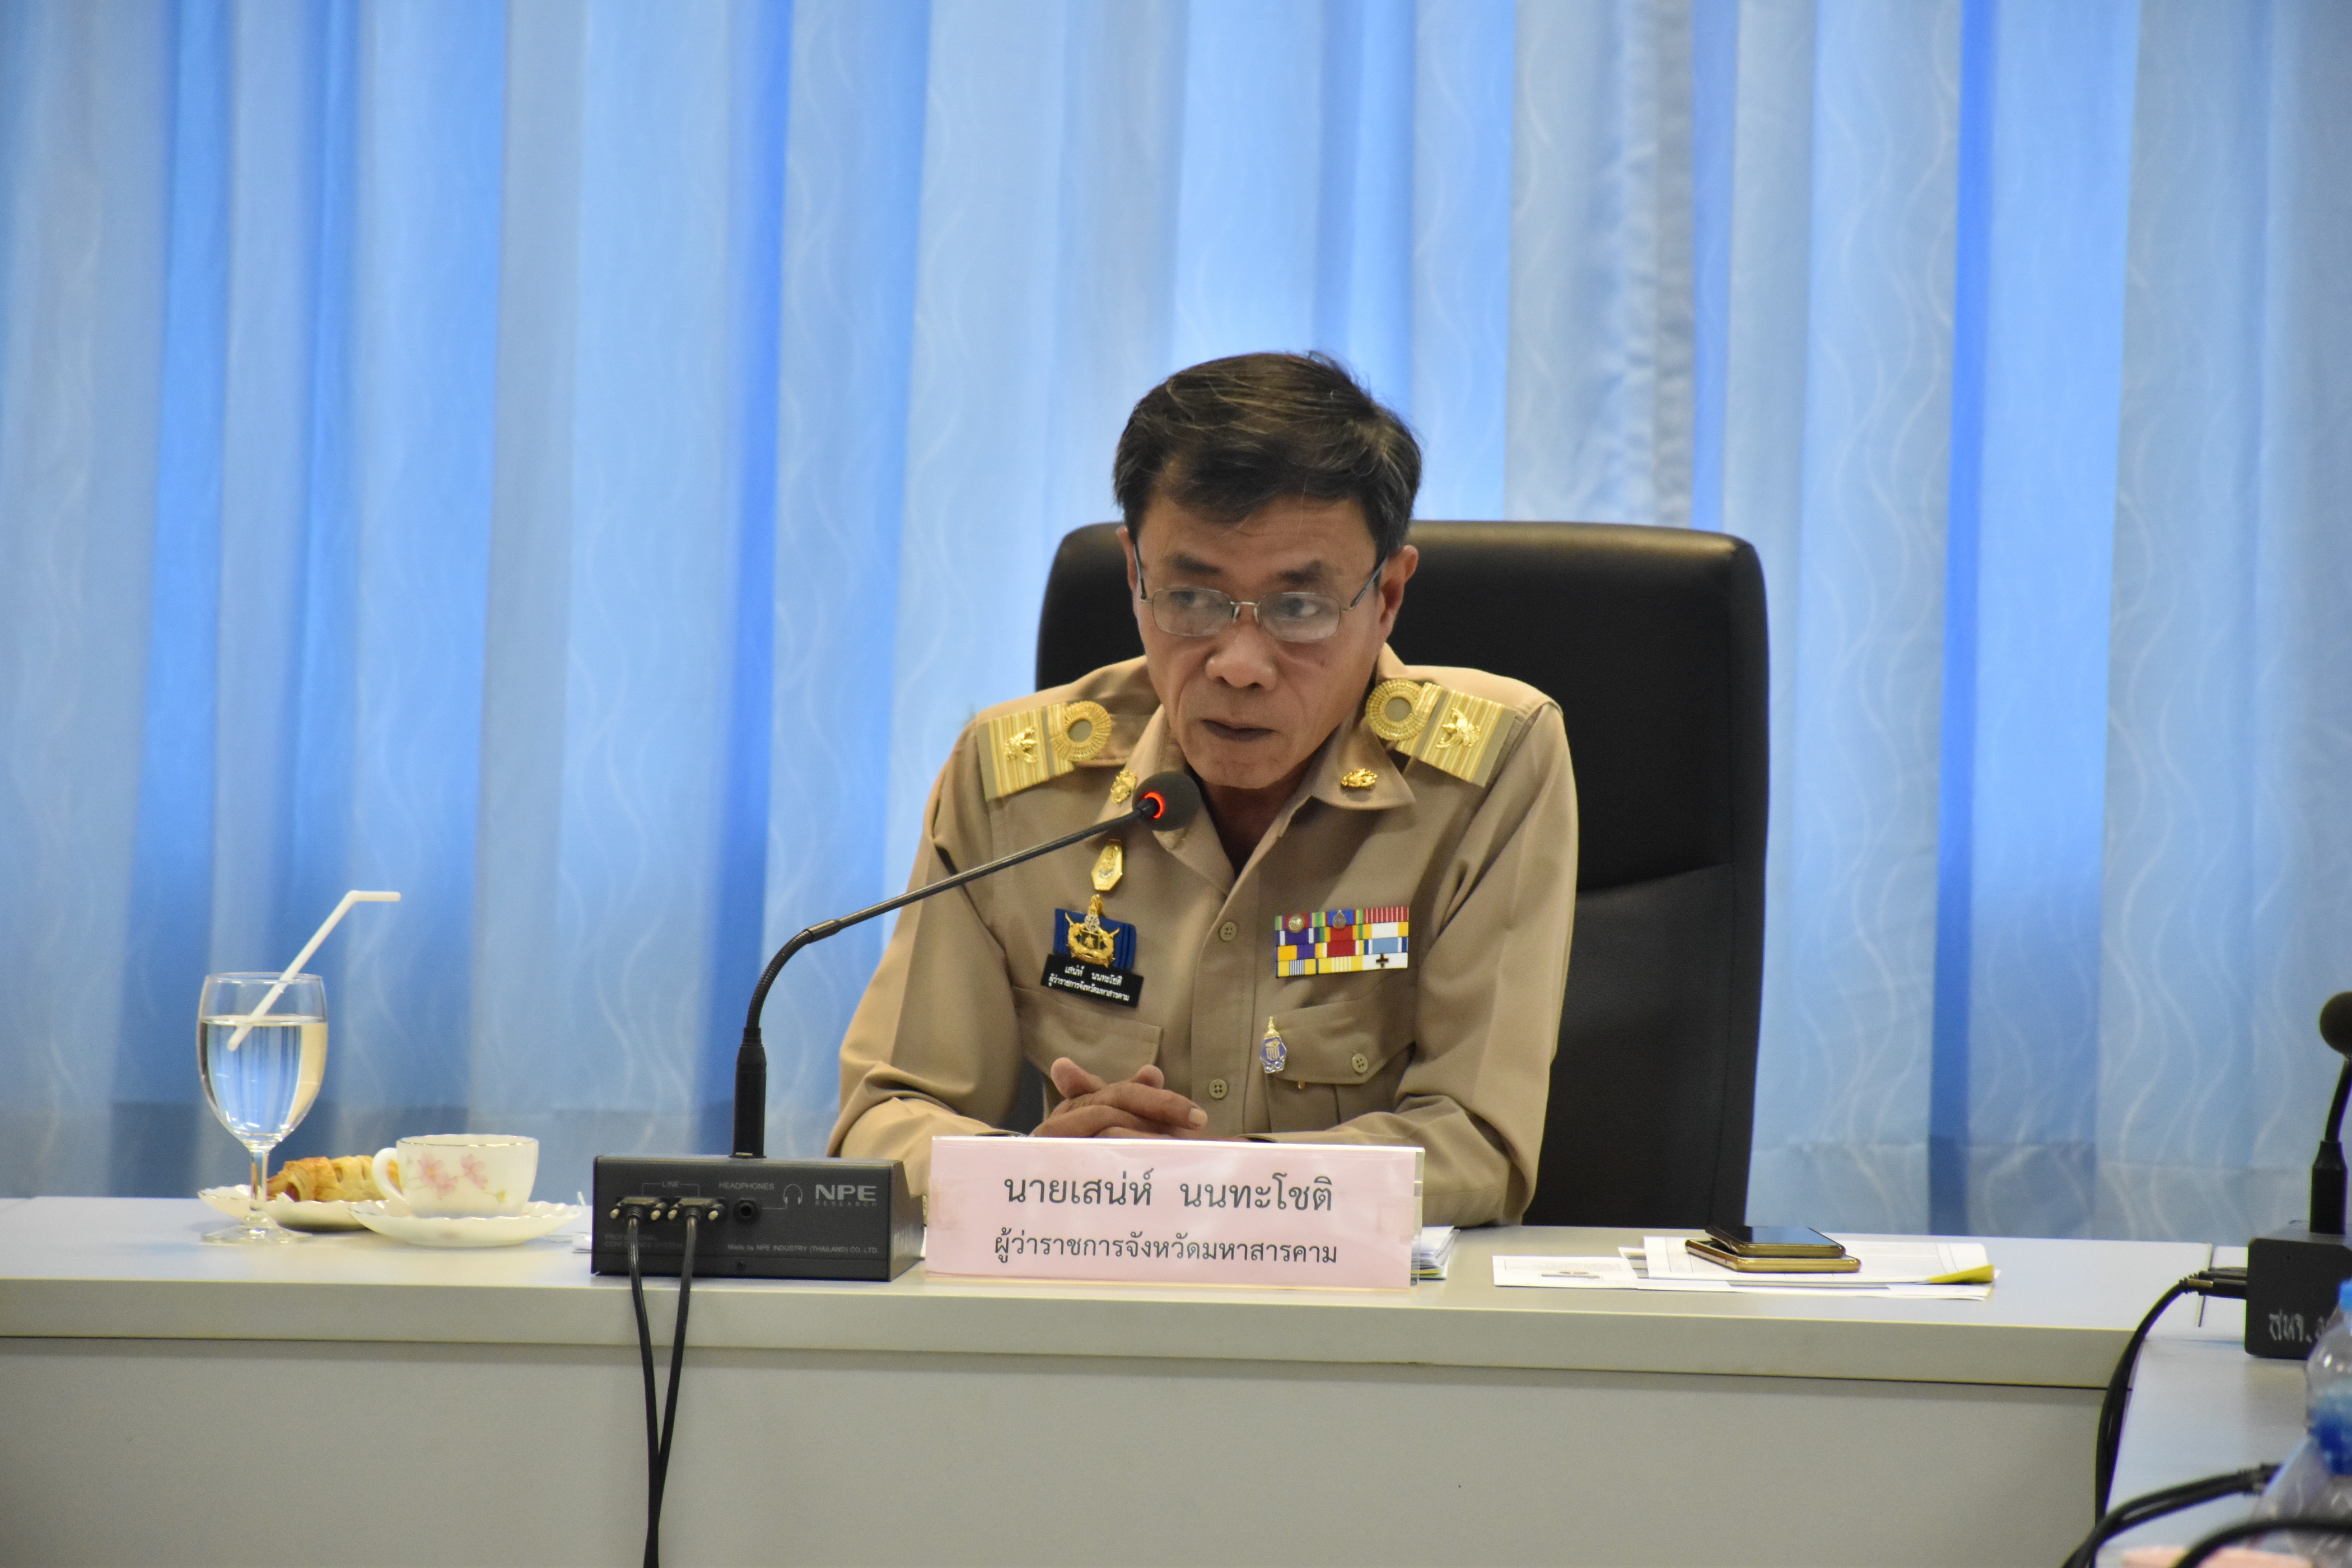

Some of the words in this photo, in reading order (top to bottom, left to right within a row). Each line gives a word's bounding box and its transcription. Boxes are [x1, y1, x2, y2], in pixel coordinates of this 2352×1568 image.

[718, 1182, 774, 1191] HEADPHONES
[815, 1184, 876, 1201] NPE
[1004, 1167, 1154, 1207] นายเสน่ห์
[1179, 1172, 1333, 1211] นนทะโชติ
[746, 1244, 754, 1252] by
[809, 1245, 848, 1253] (THAILAND)
[994, 1226, 1337, 1264] ผู้ว่าราชการจังหวัดมหาสารคาม
